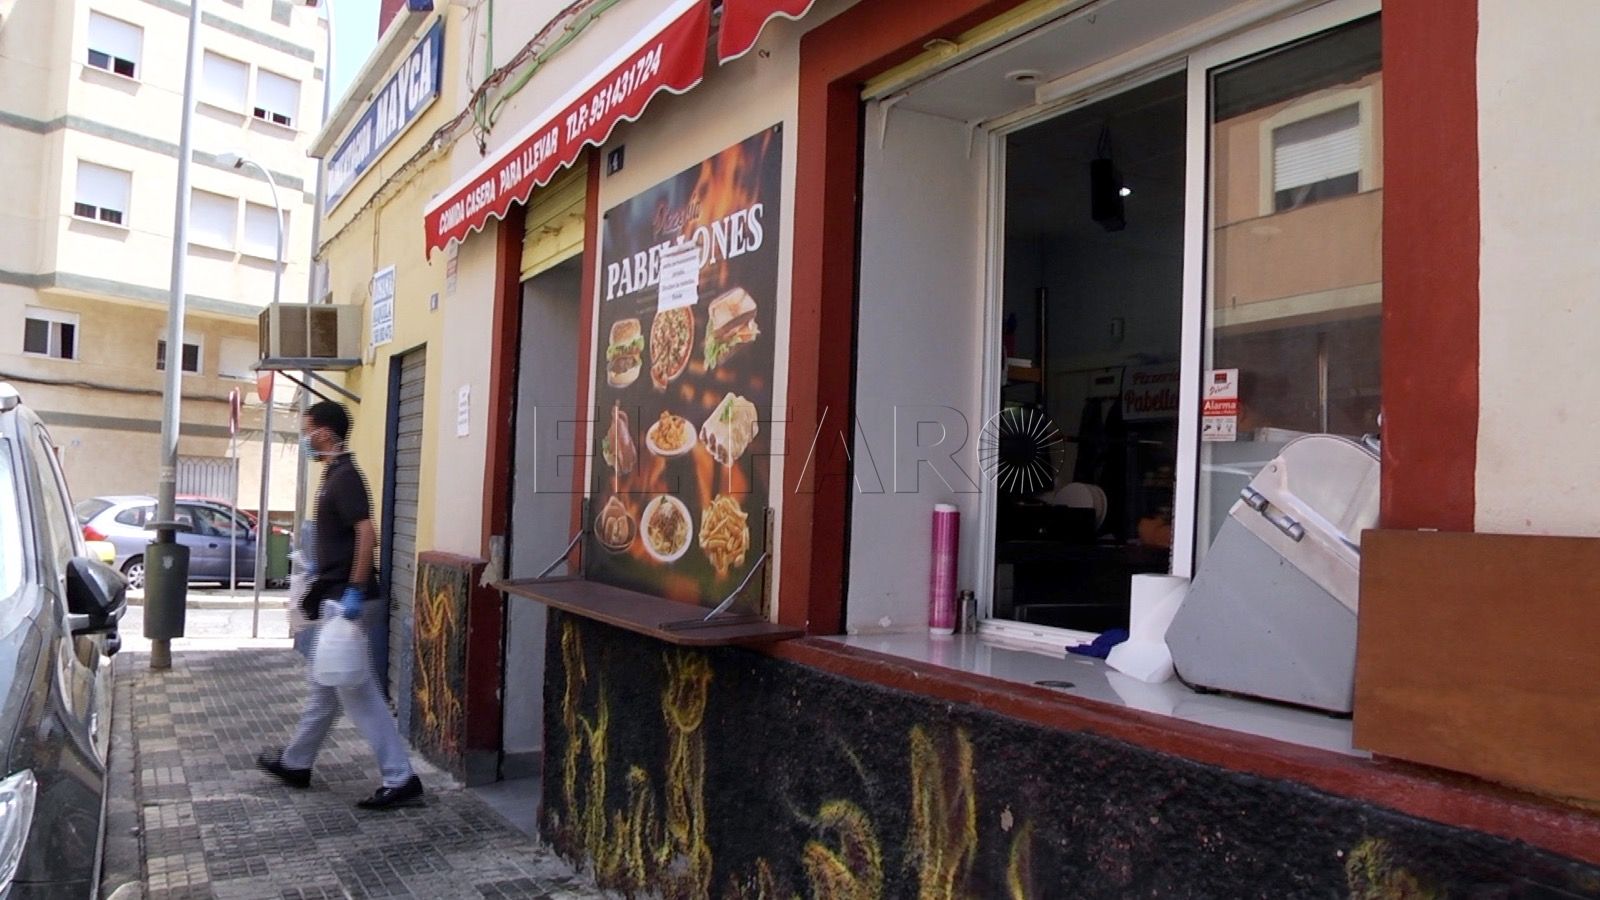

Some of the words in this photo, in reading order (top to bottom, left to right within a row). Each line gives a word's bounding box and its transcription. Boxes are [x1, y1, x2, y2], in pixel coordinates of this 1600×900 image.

[375, 37, 432, 150] MAYCA
[438, 200, 466, 236] COMIDA
[466, 177, 496, 218] CASERA
[499, 156, 522, 196] PARA
[523, 127, 560, 178] LLEVAR
[589, 43, 663, 126] 951431724
[606, 203, 763, 302] PABEONES
[1204, 400, 1237, 411] Alarma
